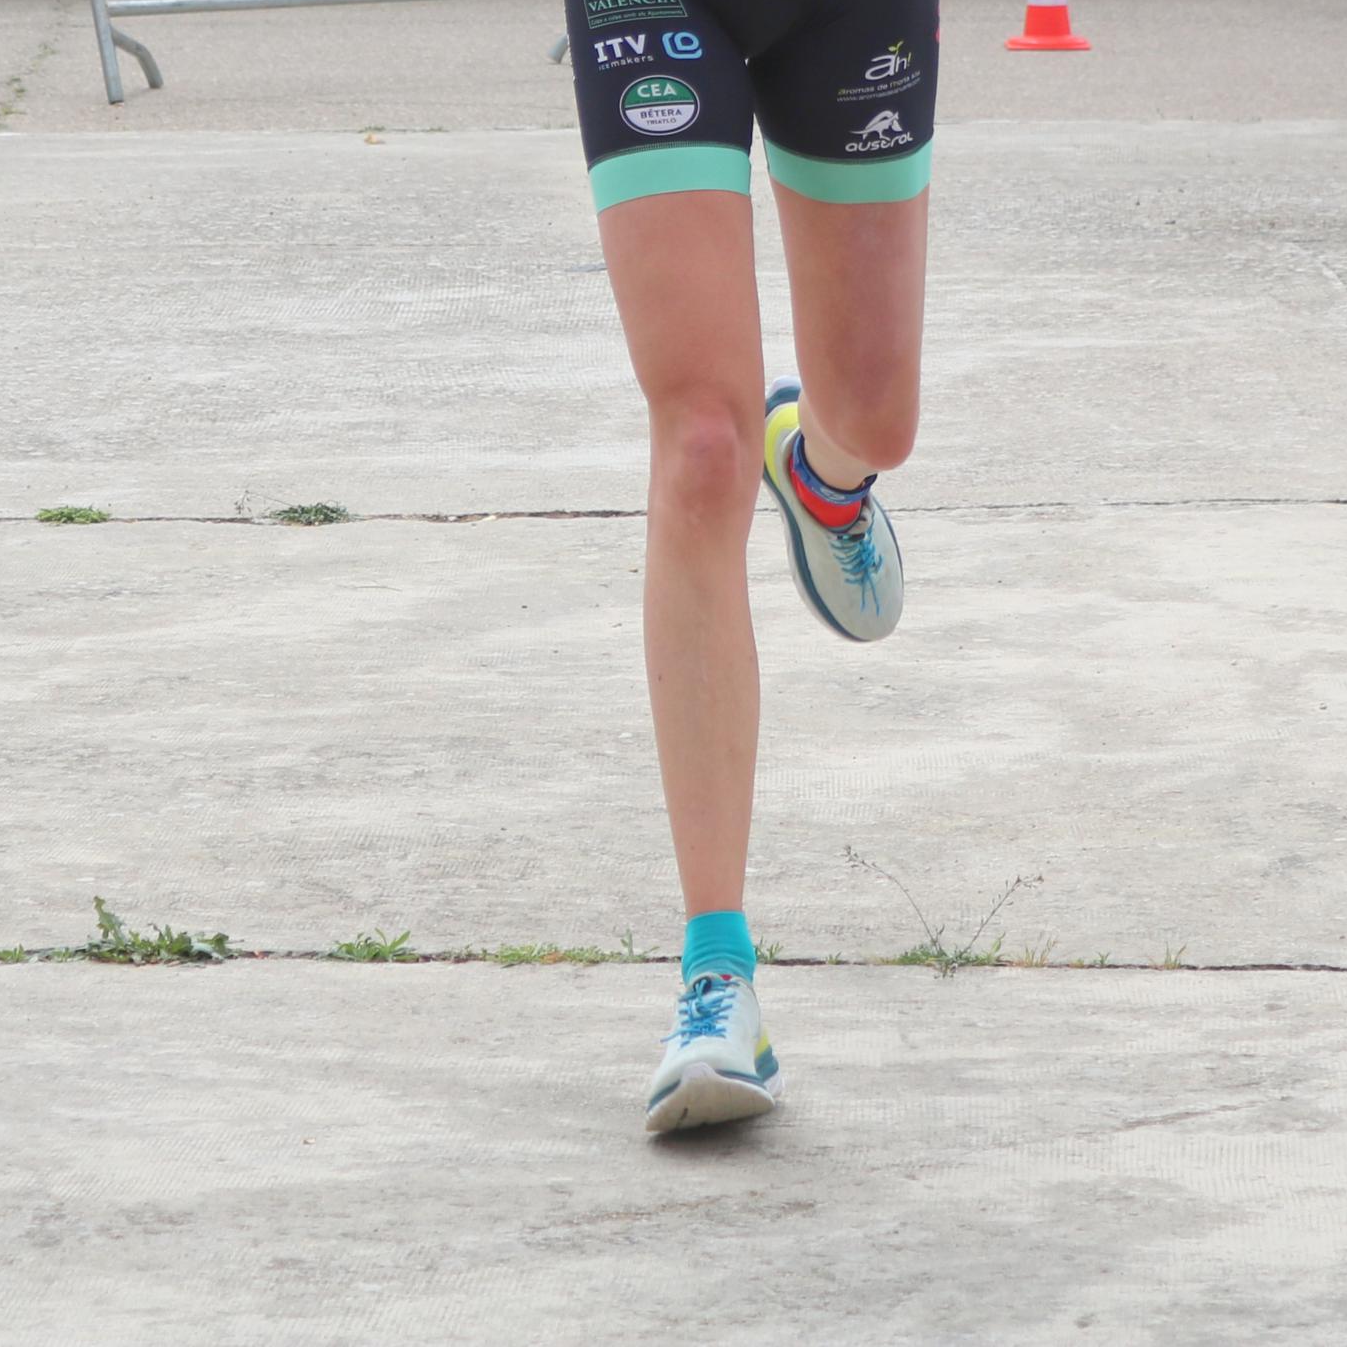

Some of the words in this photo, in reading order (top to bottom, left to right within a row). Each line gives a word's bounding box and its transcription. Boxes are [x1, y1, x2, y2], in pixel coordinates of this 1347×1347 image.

[594, 33, 646, 63] ITV
[637, 83, 677, 98] CEA
[640, 108, 682, 119] BÉTERA
